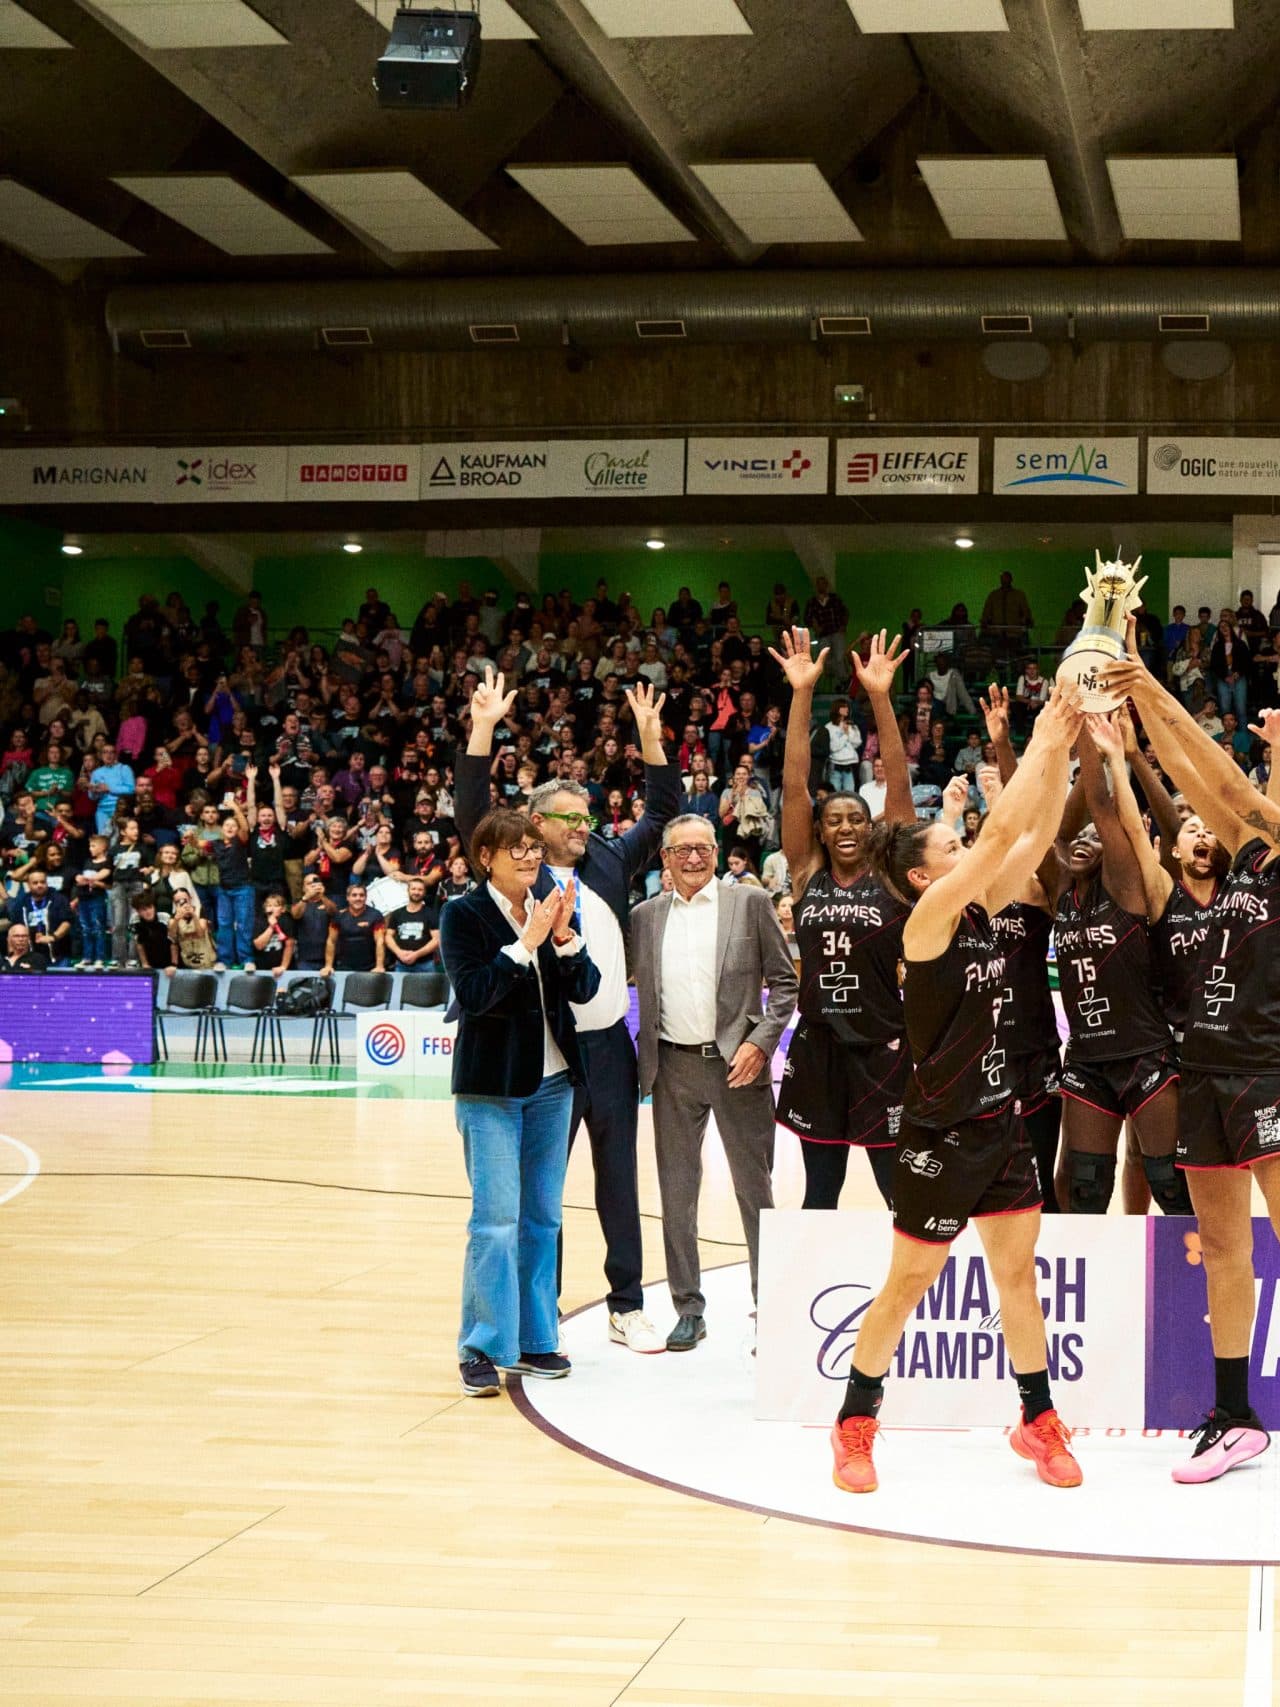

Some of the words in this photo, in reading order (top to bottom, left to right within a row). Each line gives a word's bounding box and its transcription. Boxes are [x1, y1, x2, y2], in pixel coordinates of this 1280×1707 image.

[208, 459, 256, 480] idex
[460, 454, 546, 469] KAUFMAN
[704, 460, 776, 470] VINCI
[883, 452, 968, 470] EIFFAGE
[1180, 458, 1217, 477] OGIC
[33, 466, 147, 484] MARIGNAN
[300, 465, 408, 482] LAMOTTE
[460, 472, 522, 486] BROAD
[800, 904, 883, 926] FLAMMES
[823, 931, 852, 956] 34
[1071, 957, 1097, 983] 75
[423, 1037, 456, 1055] FFB
[939, 1218, 958, 1226] auto
